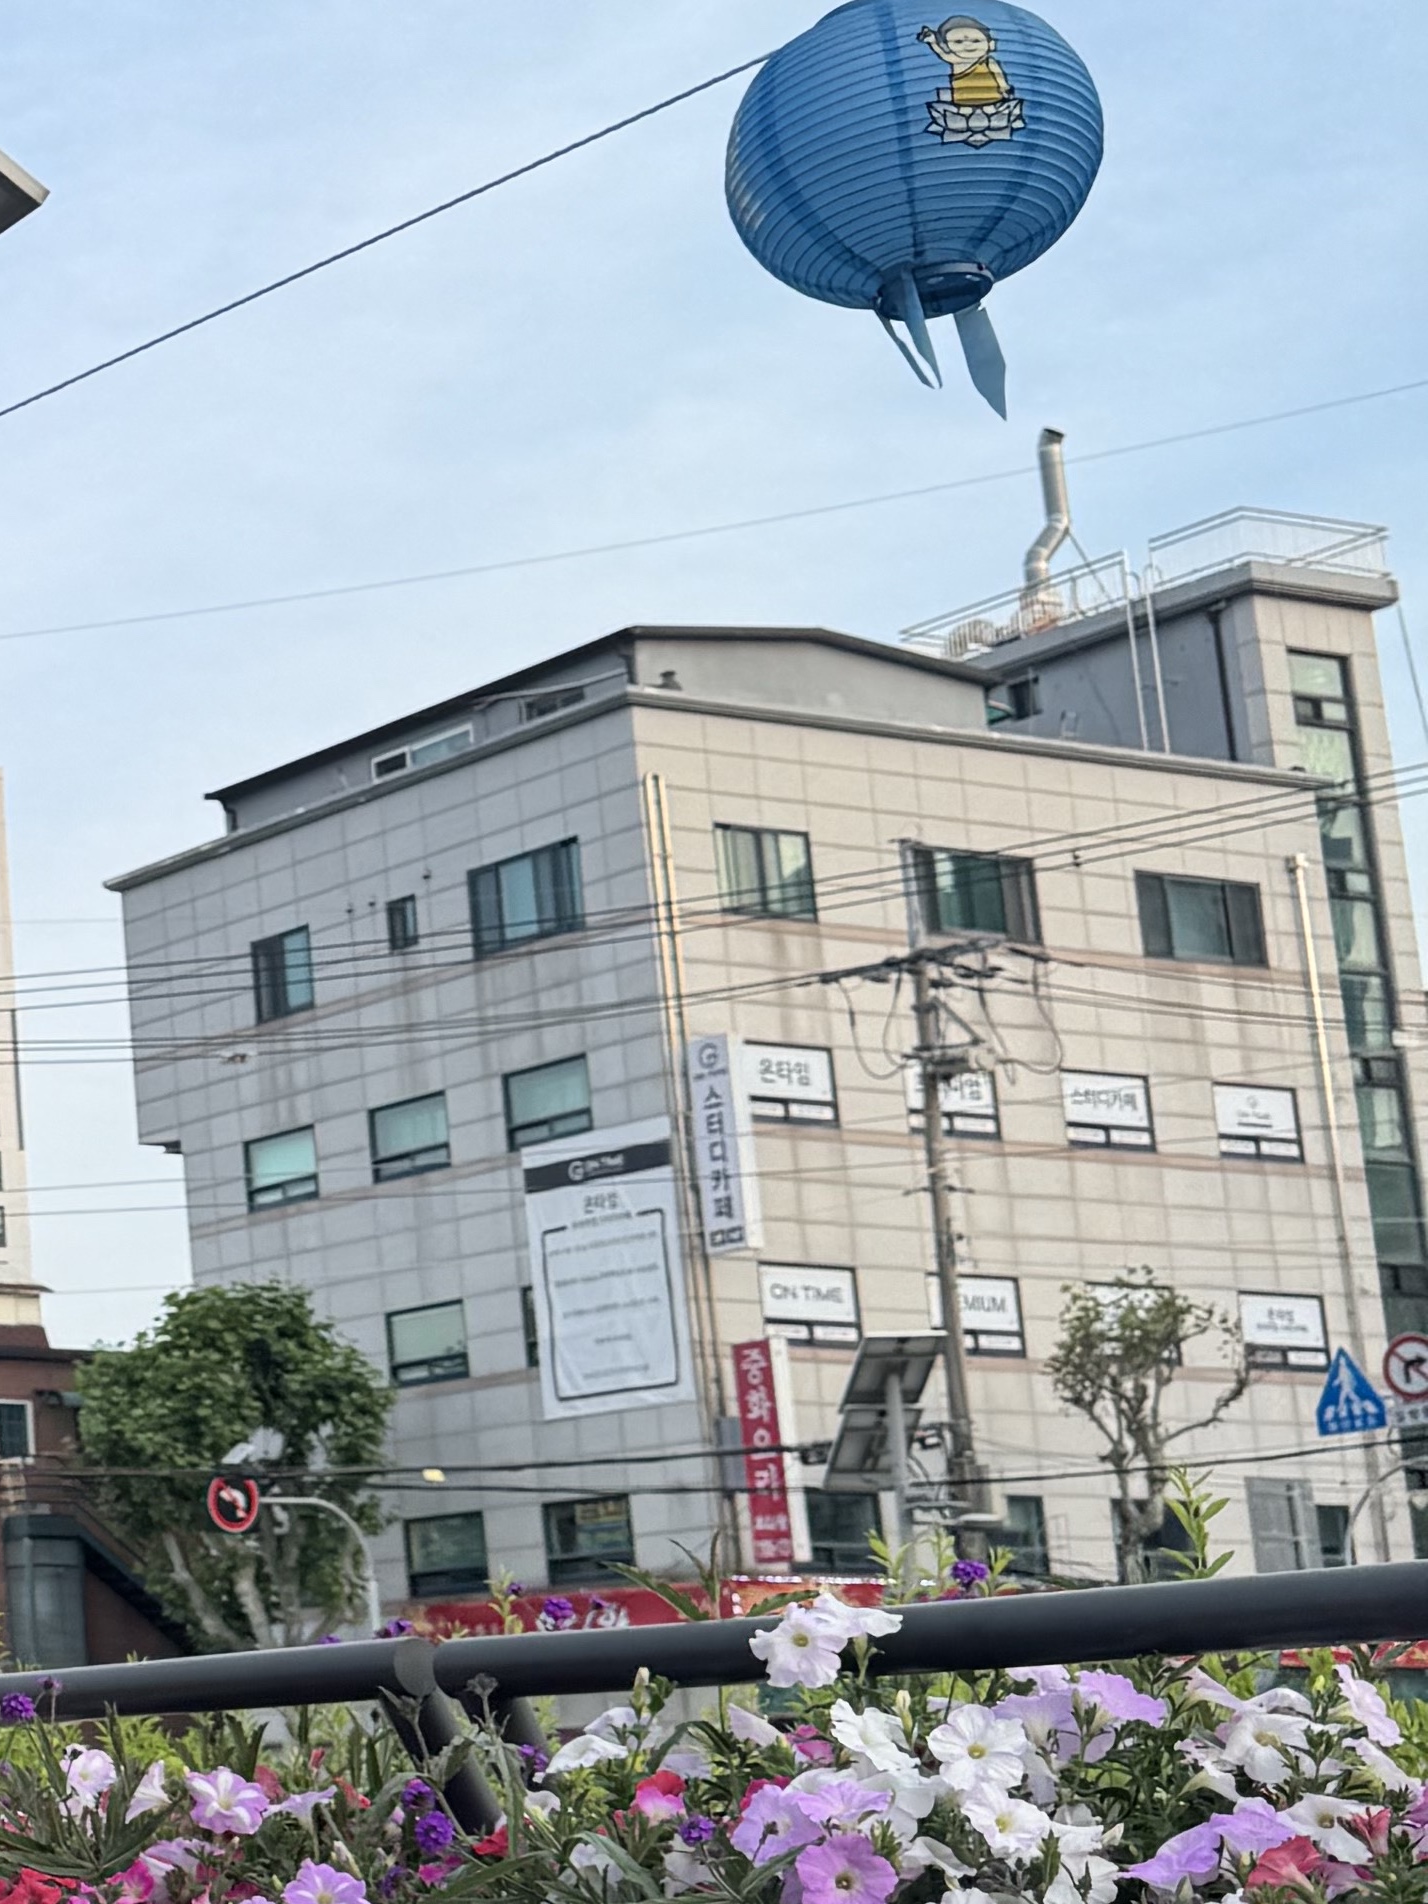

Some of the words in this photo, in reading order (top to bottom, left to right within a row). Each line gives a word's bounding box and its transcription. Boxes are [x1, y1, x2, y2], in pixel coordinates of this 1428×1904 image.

[759, 1058, 812, 1087] 온타임
[702, 1085, 733, 1220] 스터디카페
[803, 1284, 845, 1305] TIME
